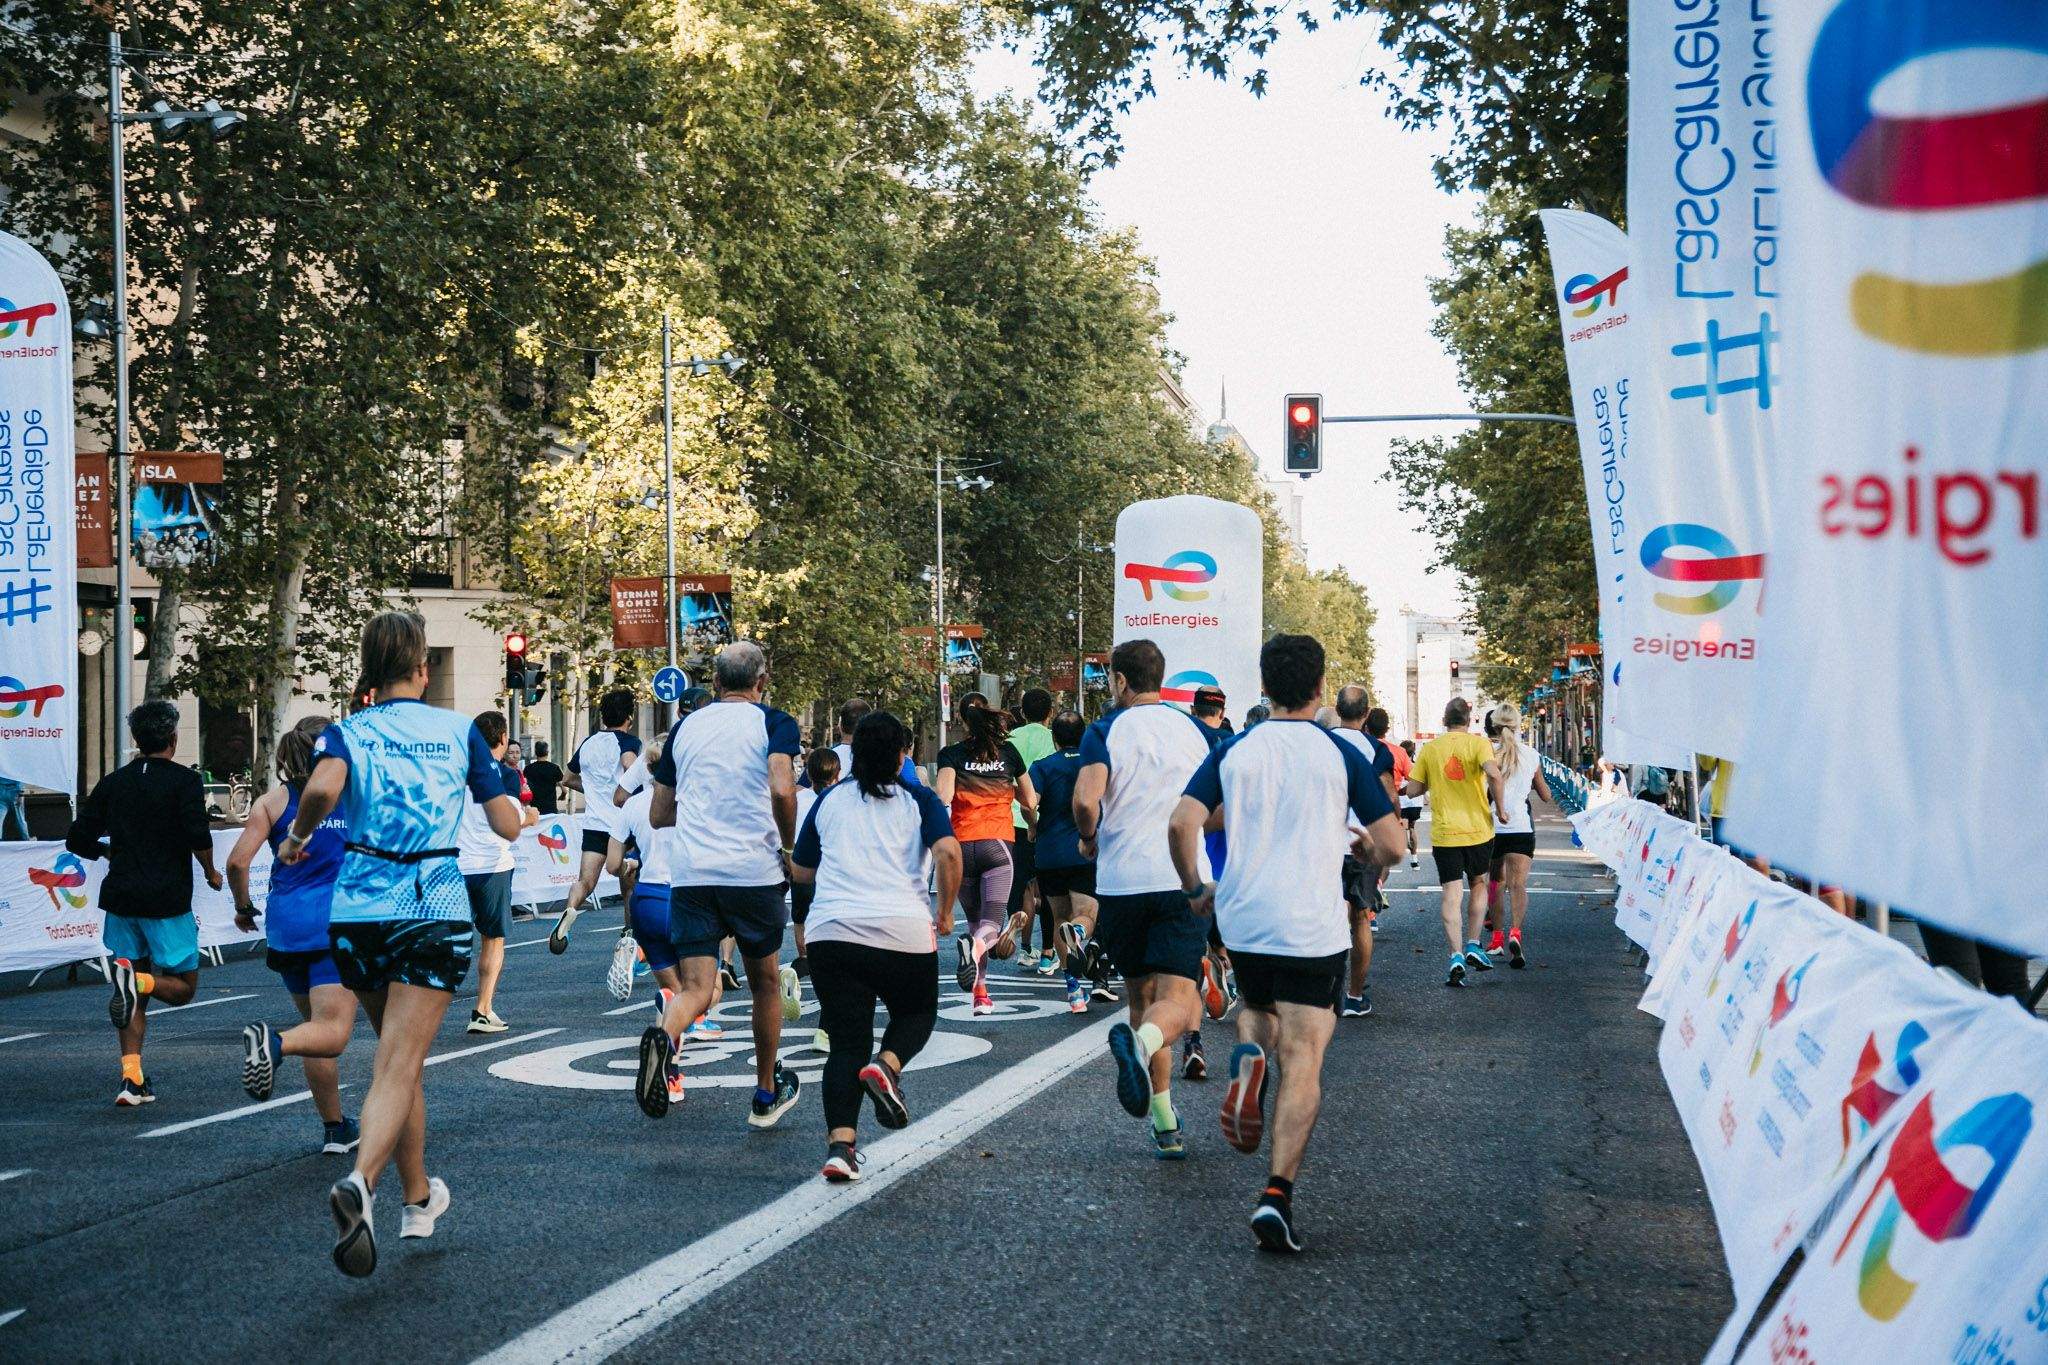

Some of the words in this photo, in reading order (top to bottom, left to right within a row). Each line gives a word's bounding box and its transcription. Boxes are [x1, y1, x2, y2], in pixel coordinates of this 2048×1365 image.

[140, 465, 177, 479] ISLA
[682, 582, 705, 591] ISLA
[616, 589, 658, 599] FERNÁN
[617, 599, 659, 608] GÓMEZ
[1124, 613, 1219, 628] TotalEnergies
[384, 741, 450, 754] HYUNDAI
